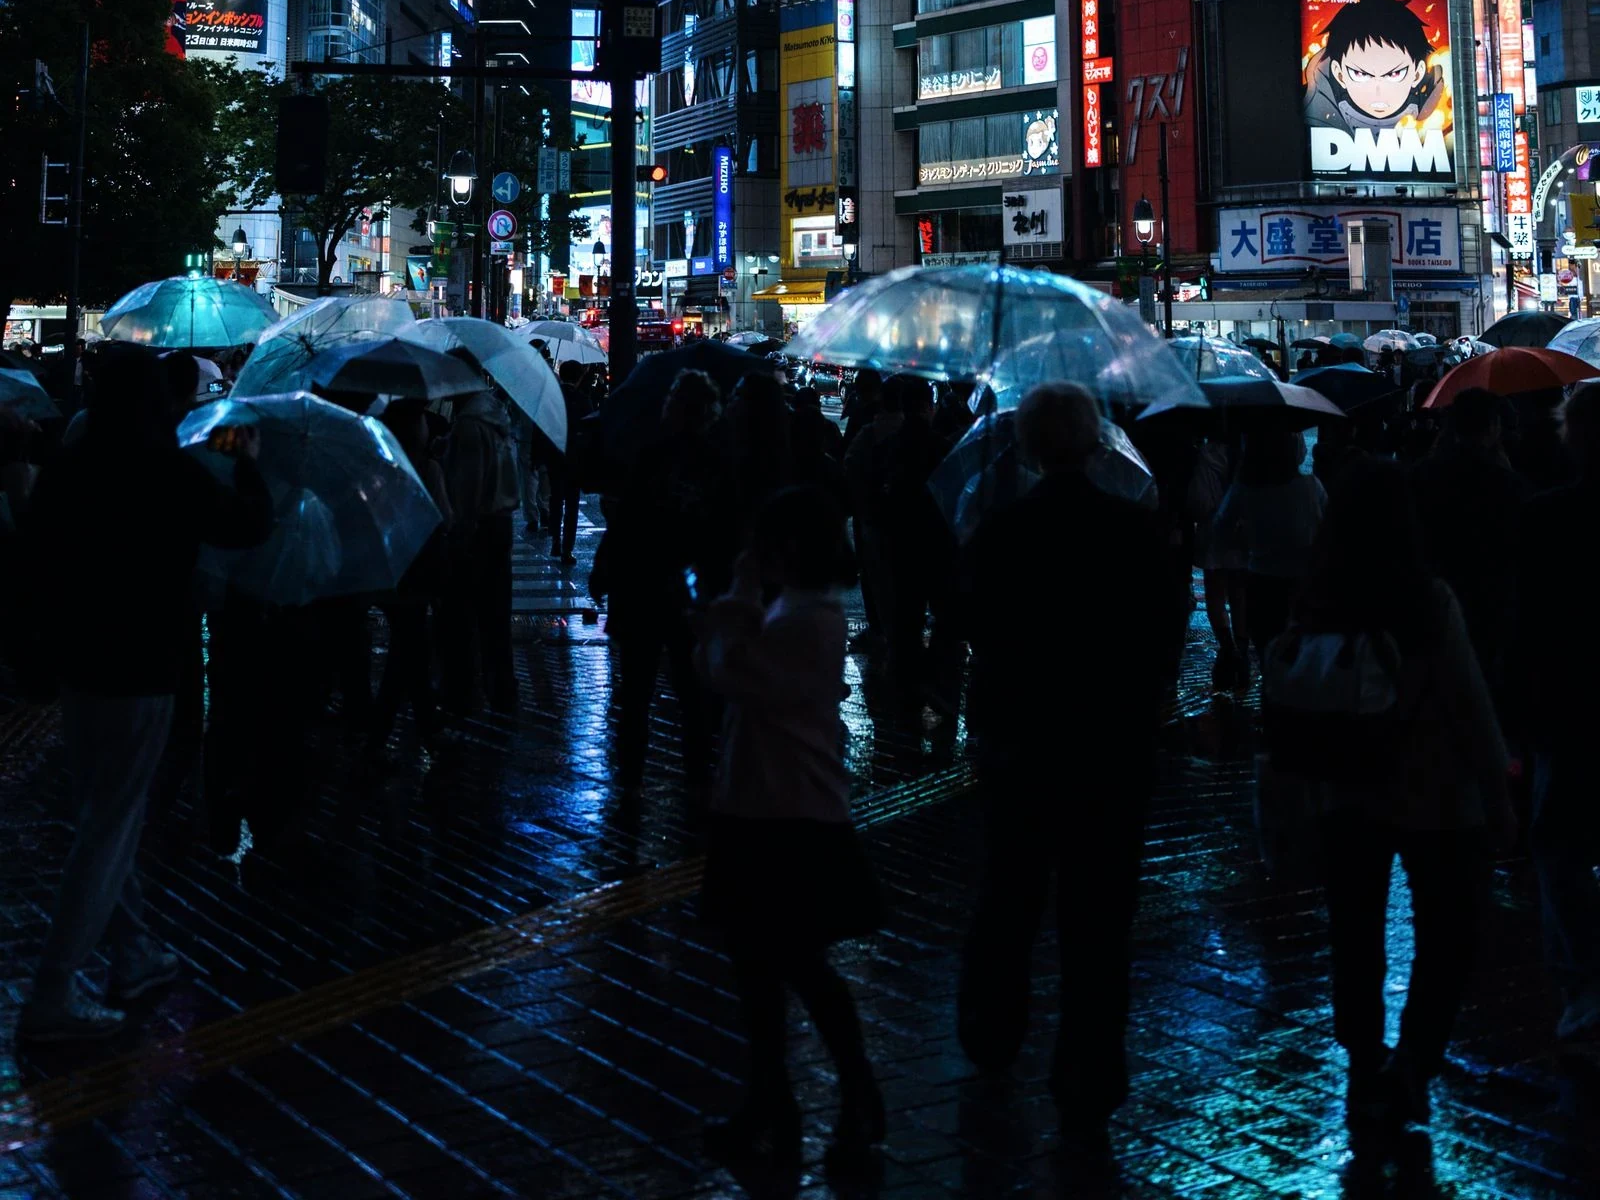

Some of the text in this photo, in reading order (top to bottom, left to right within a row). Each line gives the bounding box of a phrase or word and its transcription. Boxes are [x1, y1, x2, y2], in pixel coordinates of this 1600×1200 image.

[196, 24, 264, 36] ファイナル・レコニング
[783, 39, 819, 52] Matsumoto
[791, 101, 826, 154] 薬
[1124, 47, 1189, 165] クスリ
[1311, 126, 1452, 173] DMM
[1497, 97, 1512, 169] 大盛堂商事ビル
[719, 155, 729, 194] MIZUHO
[1023, 157, 1060, 176] Jasmine
[1231, 216, 1442, 259] 大盛堂店
